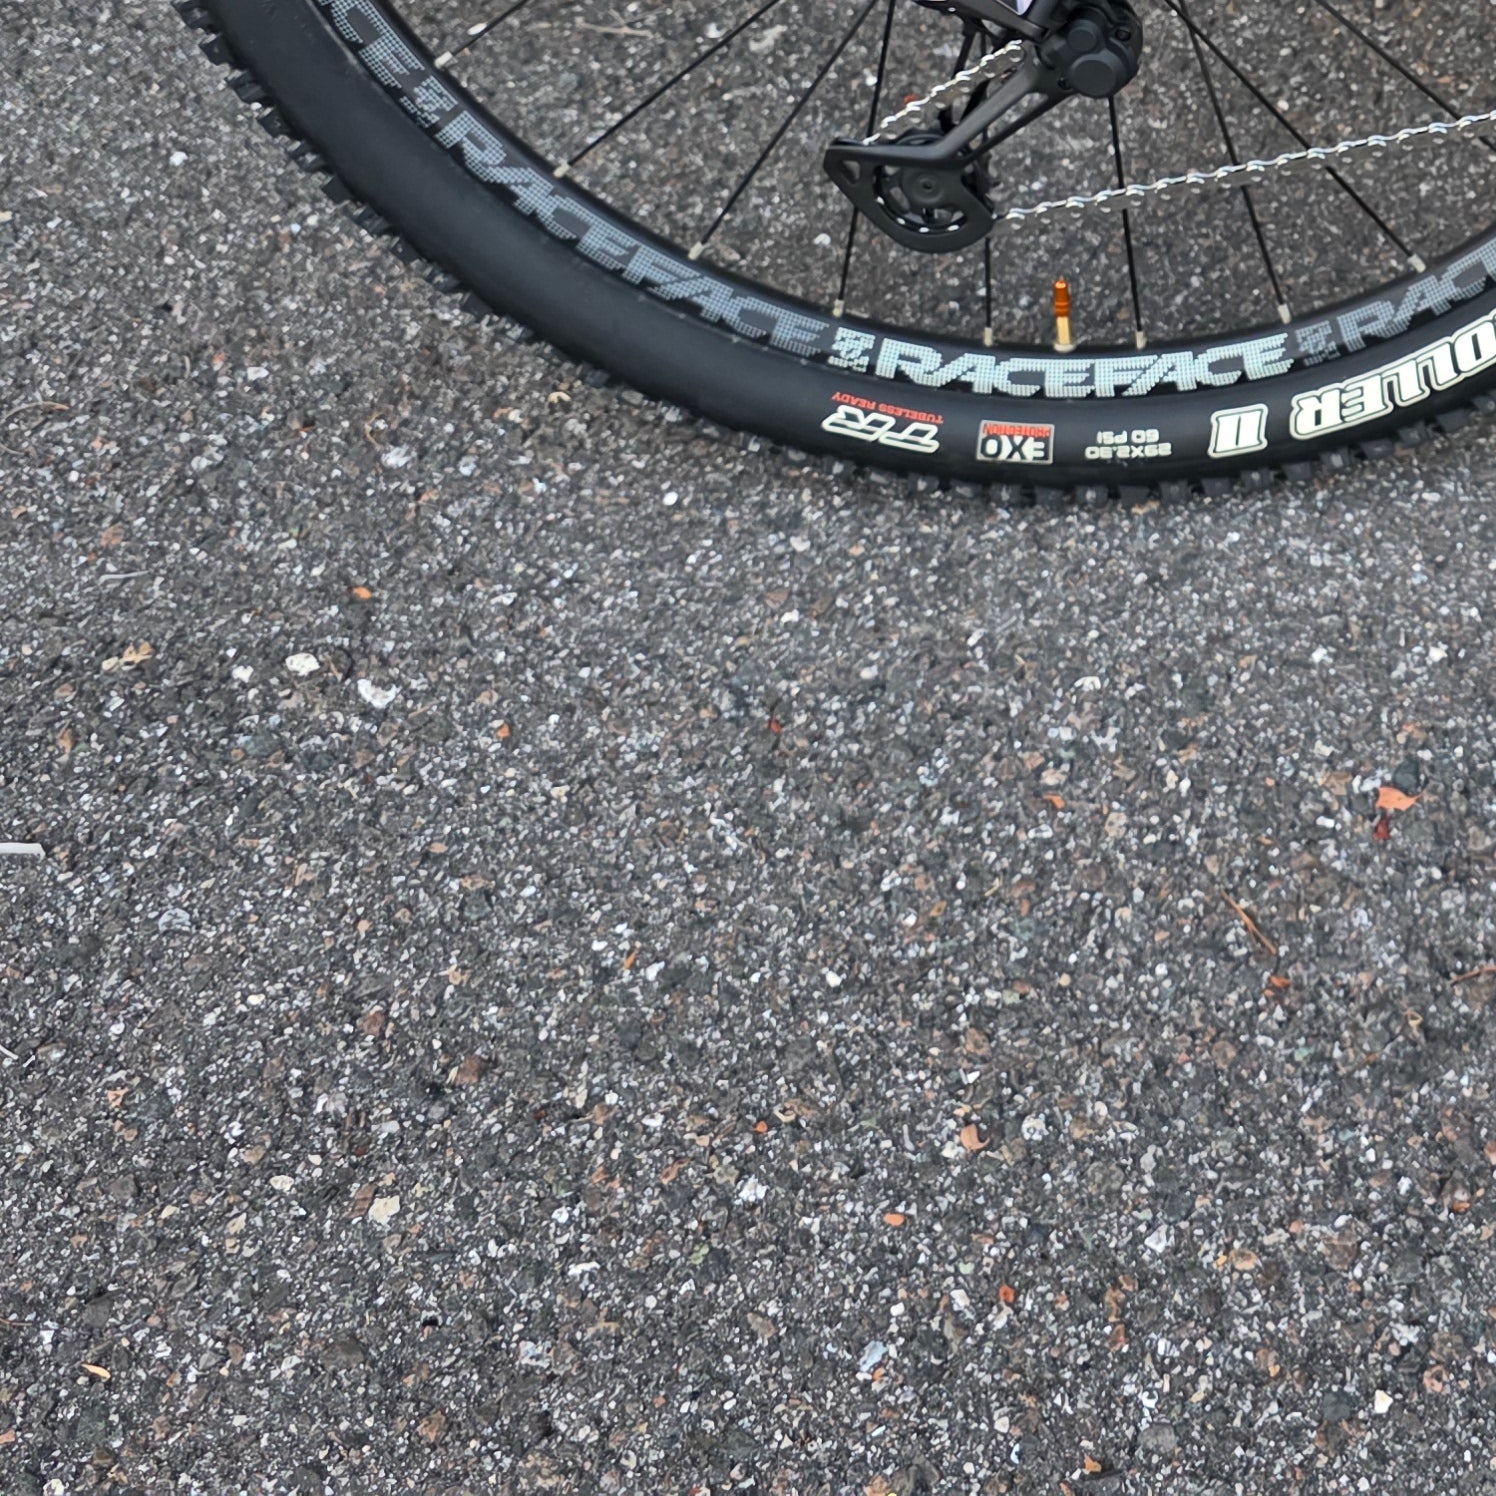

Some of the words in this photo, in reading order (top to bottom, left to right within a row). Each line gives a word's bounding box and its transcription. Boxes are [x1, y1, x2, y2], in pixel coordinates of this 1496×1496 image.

[875, 332, 1294, 398] RACEFACE
[830, 391, 875, 410] READY
[877, 402, 944, 424] TUBELESS
[820, 404, 940, 454] TR
[1096, 429, 1128, 445] PSI
[980, 434, 1050, 461] EXO
